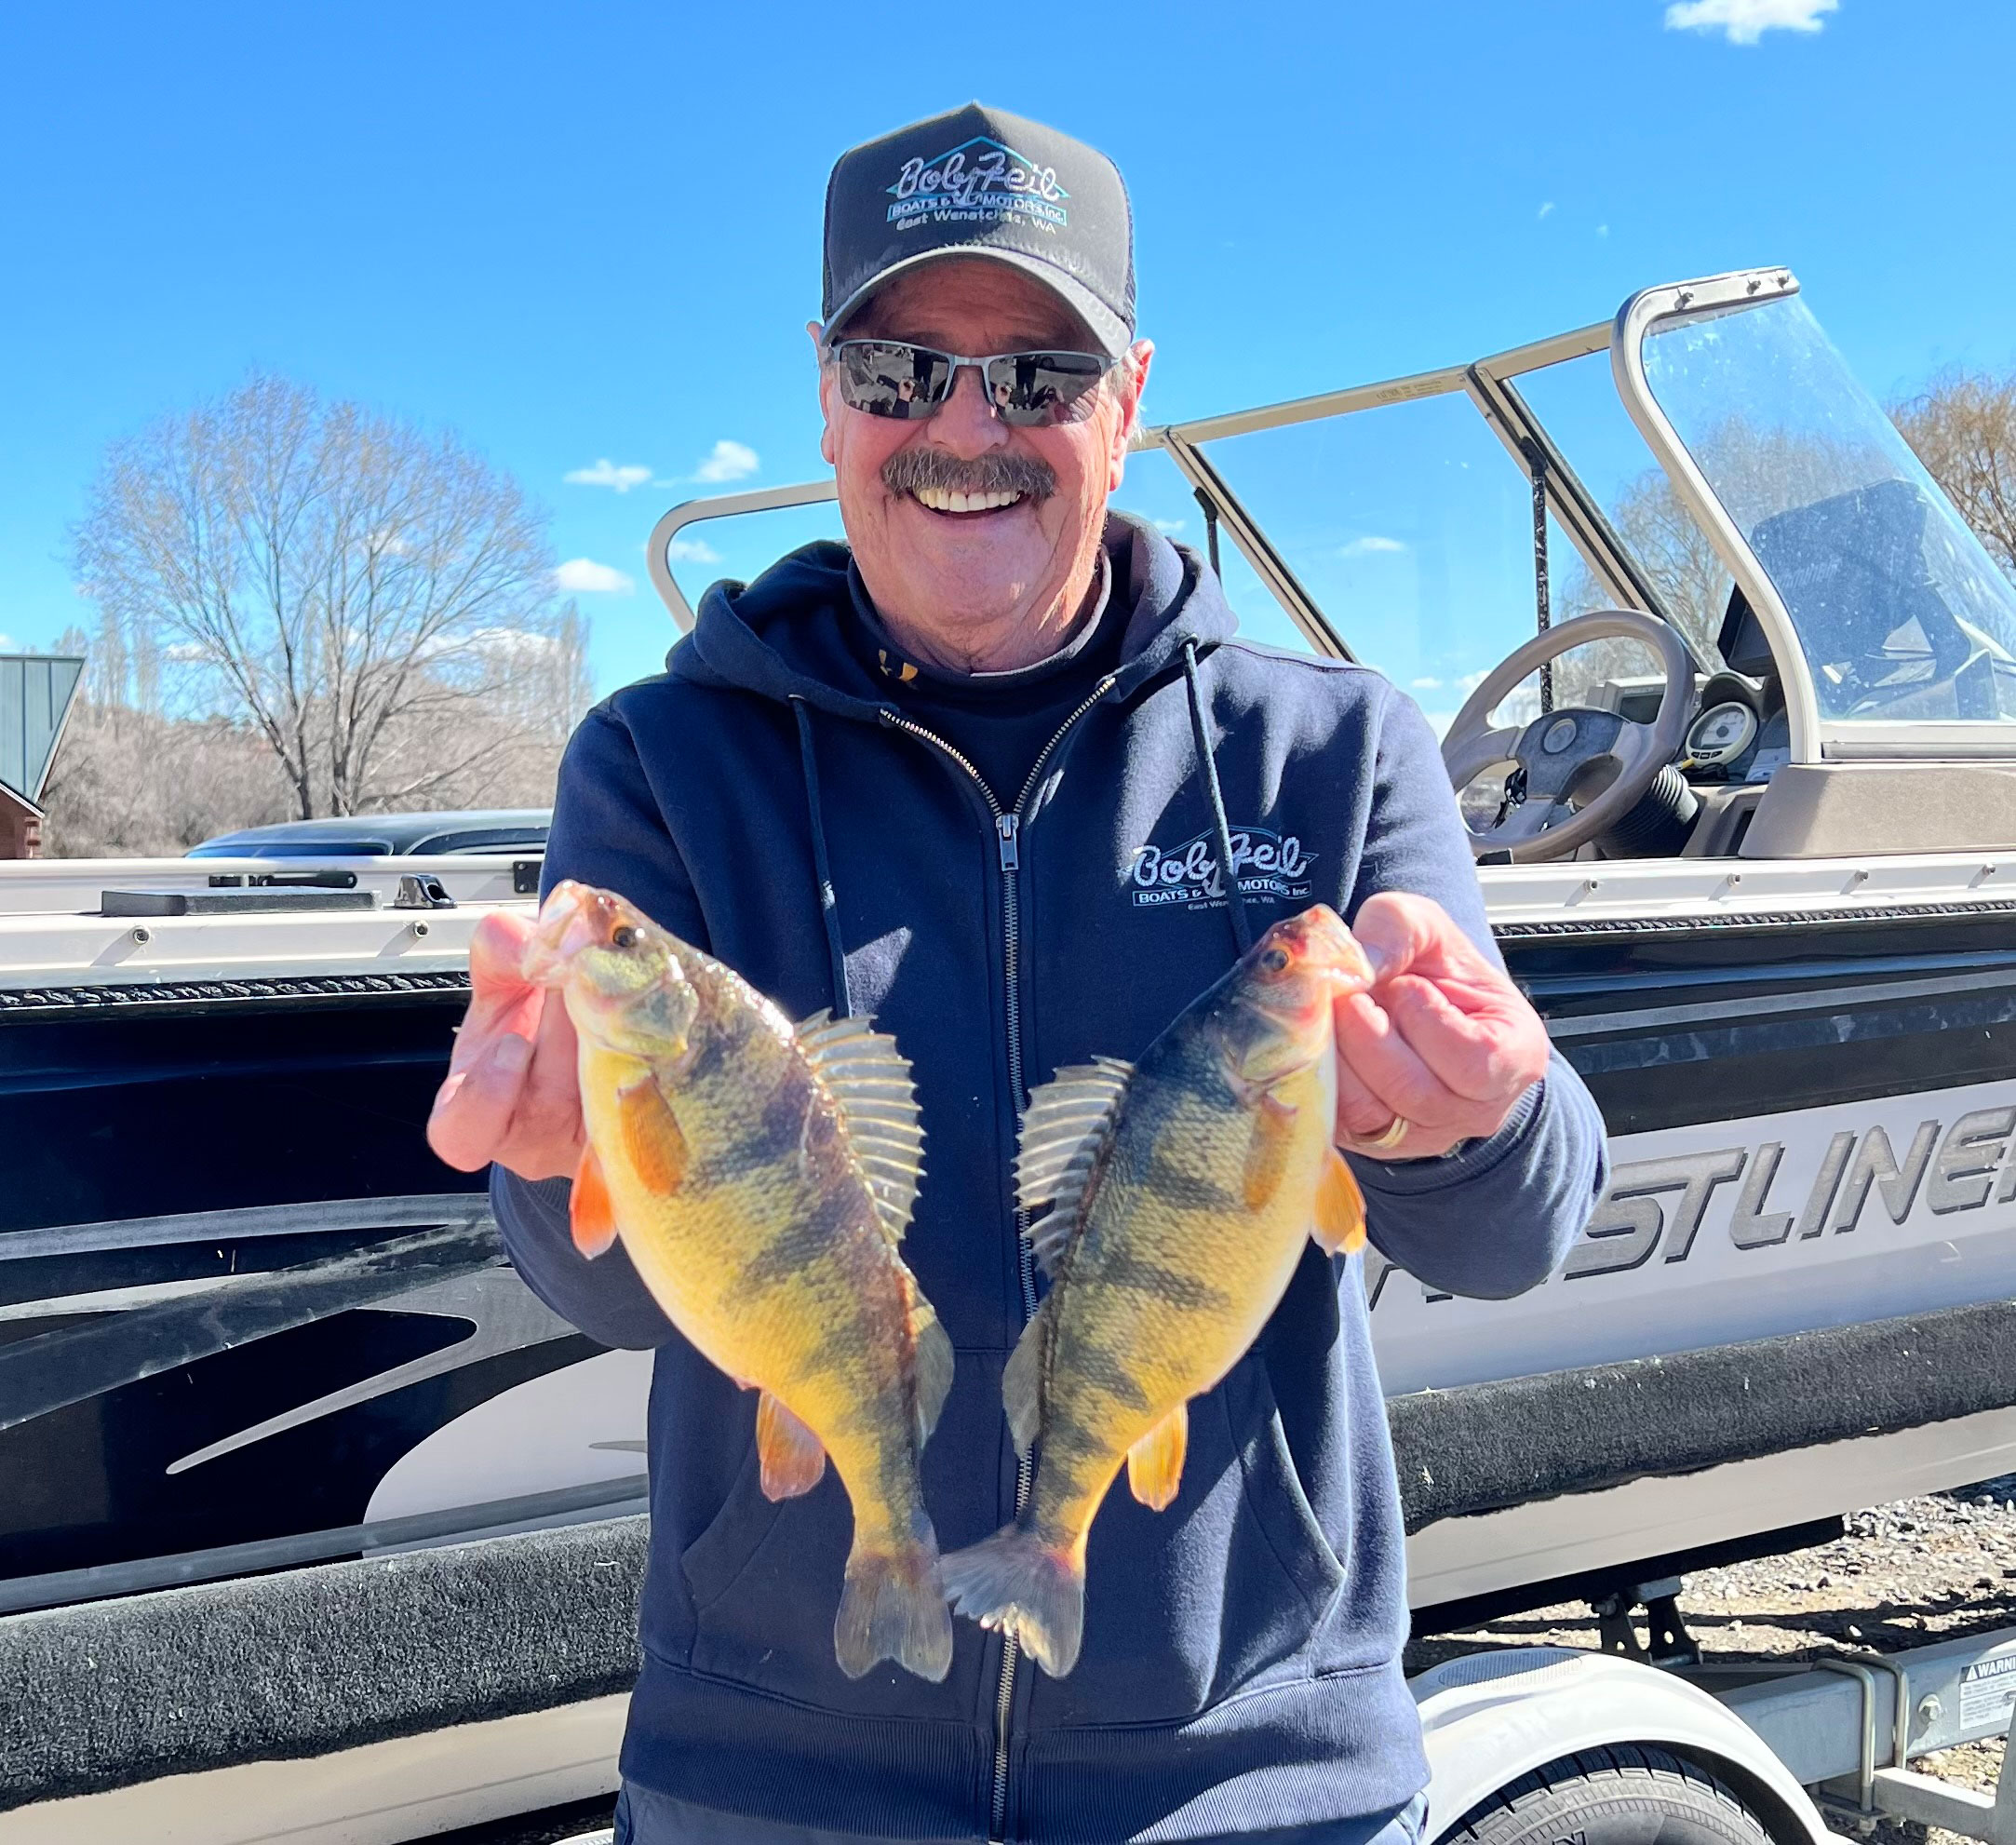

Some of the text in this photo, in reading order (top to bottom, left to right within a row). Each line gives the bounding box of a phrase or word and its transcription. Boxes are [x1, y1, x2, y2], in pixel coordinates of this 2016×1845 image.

[892, 197, 938, 218] BOATS
[895, 212, 929, 231] East
[1031, 215, 1056, 236] WA
[1132, 840, 1217, 886] Bob
[1138, 889, 1189, 904] BOATS
[1191, 888, 1203, 897] &
[1188, 901, 1208, 910] East
[1261, 896, 1276, 904] WA
